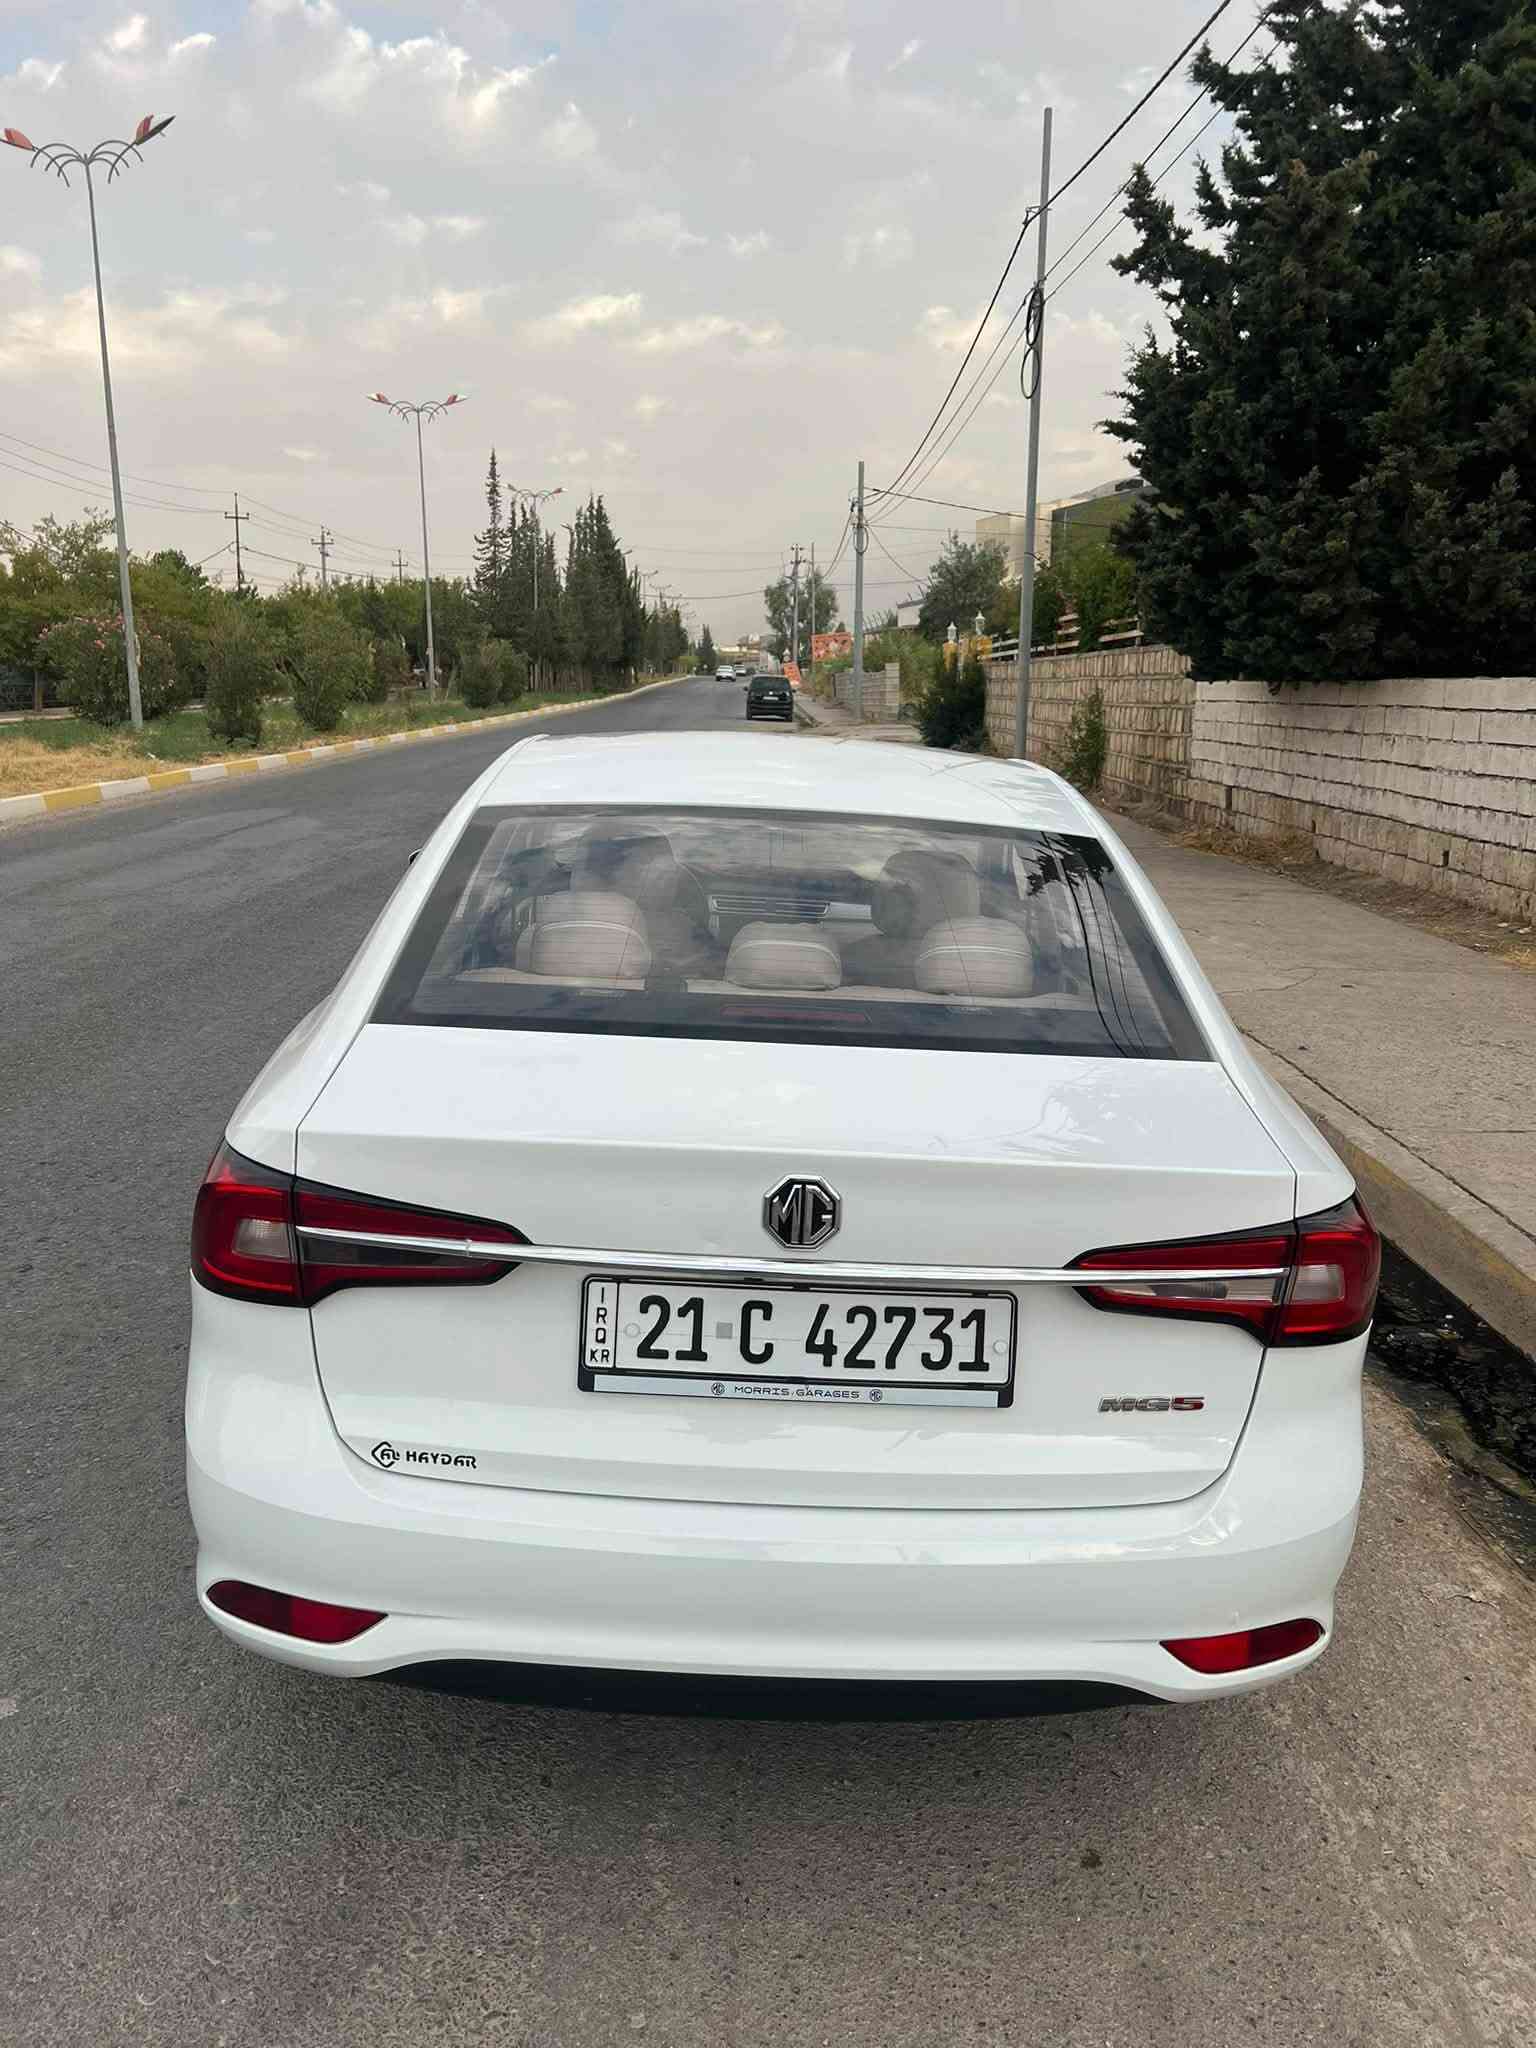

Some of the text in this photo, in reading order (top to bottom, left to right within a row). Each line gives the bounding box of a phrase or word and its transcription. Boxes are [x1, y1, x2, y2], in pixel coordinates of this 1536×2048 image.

[770, 1183, 834, 1245] MG
[636, 1294, 990, 1372] 21 C 42731
[589, 1348, 611, 1363] KR
[734, 1385, 790, 1396] MORRIS
[796, 1387, 860, 1399] GARAGES
[1098, 1397, 1205, 1412] MG5
[405, 1450, 477, 1469] HAYDAR
